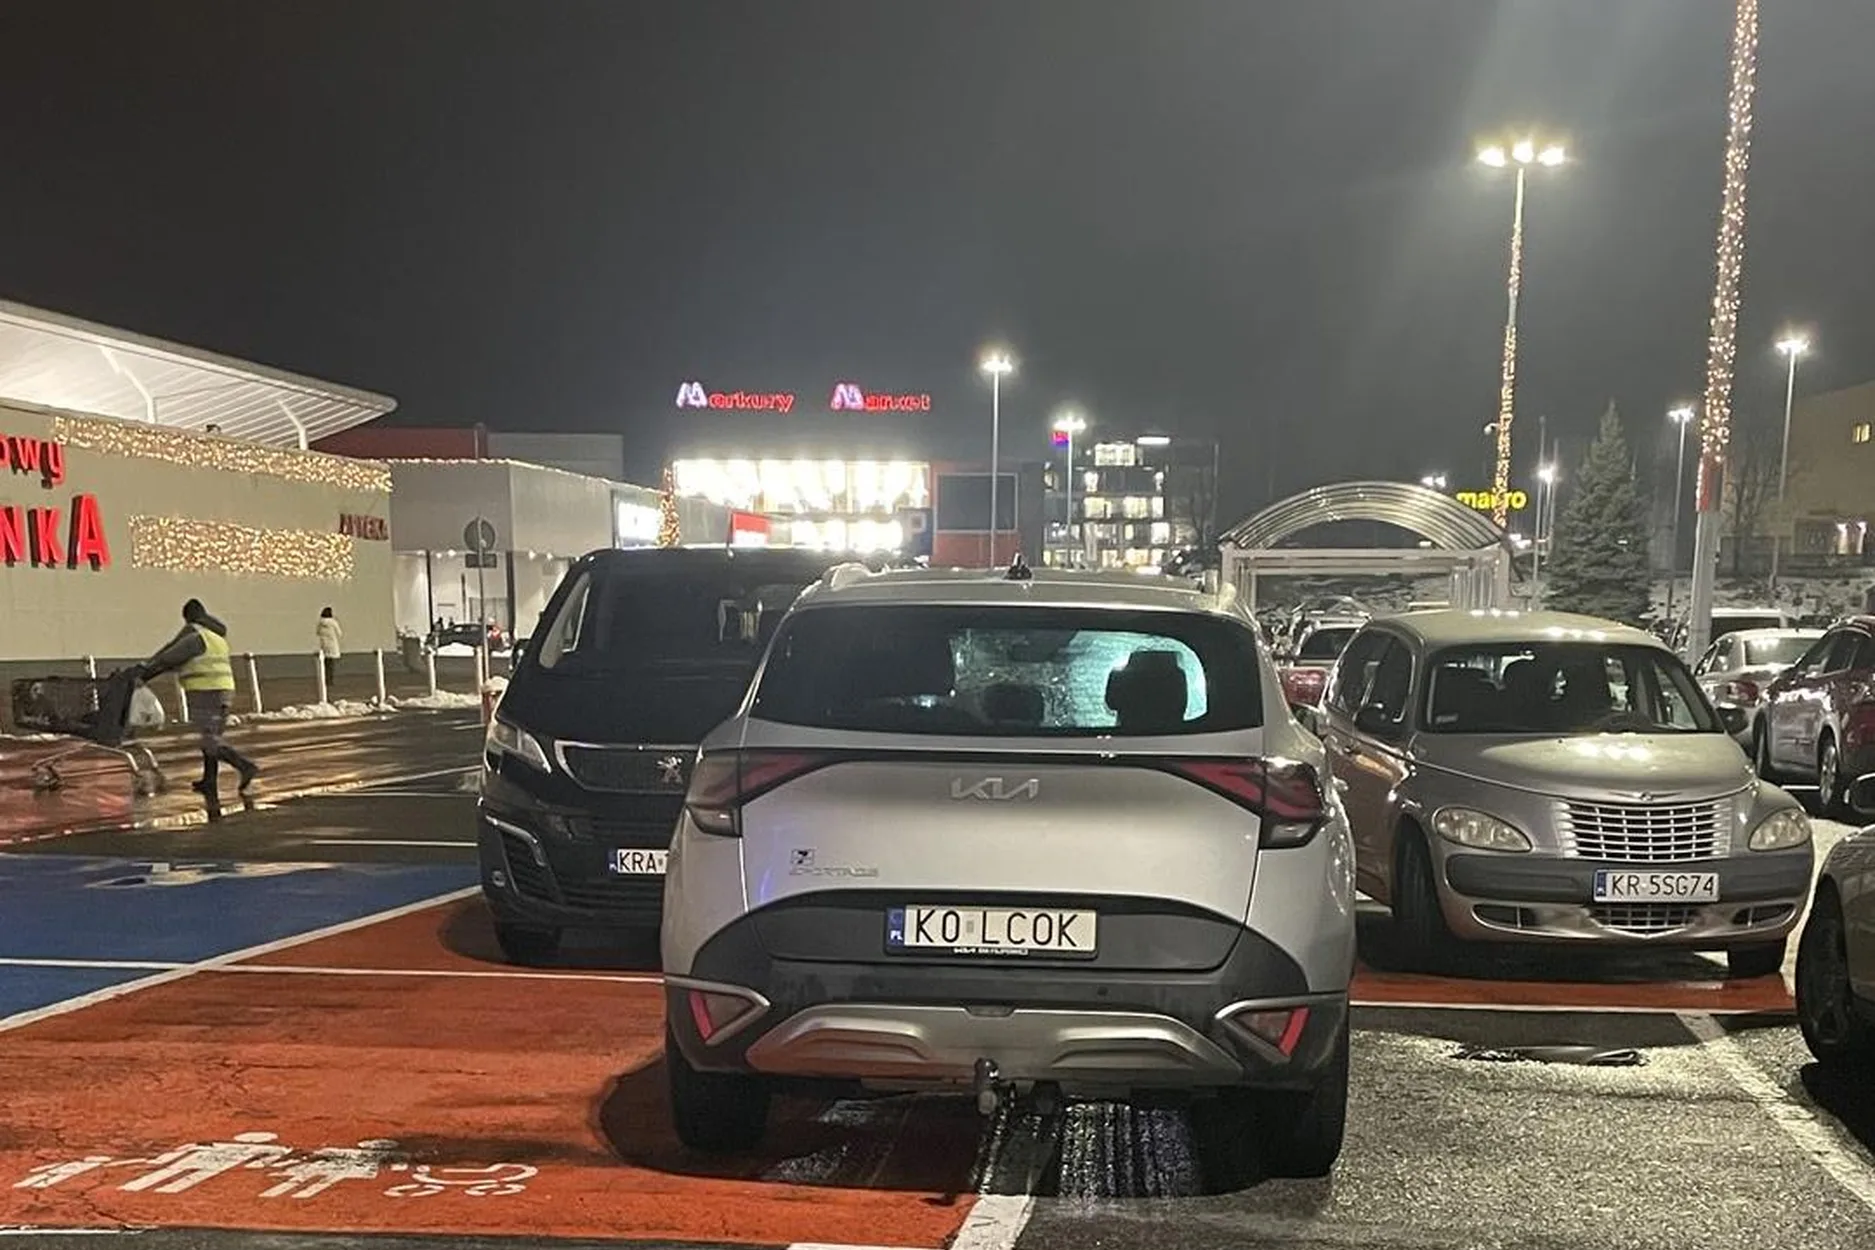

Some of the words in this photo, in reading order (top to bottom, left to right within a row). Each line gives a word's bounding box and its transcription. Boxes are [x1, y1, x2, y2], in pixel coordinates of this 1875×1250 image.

[1456, 491, 1527, 510] maro
[951, 777, 1039, 800] KIA
[1649, 875, 1715, 897] 5SG74
